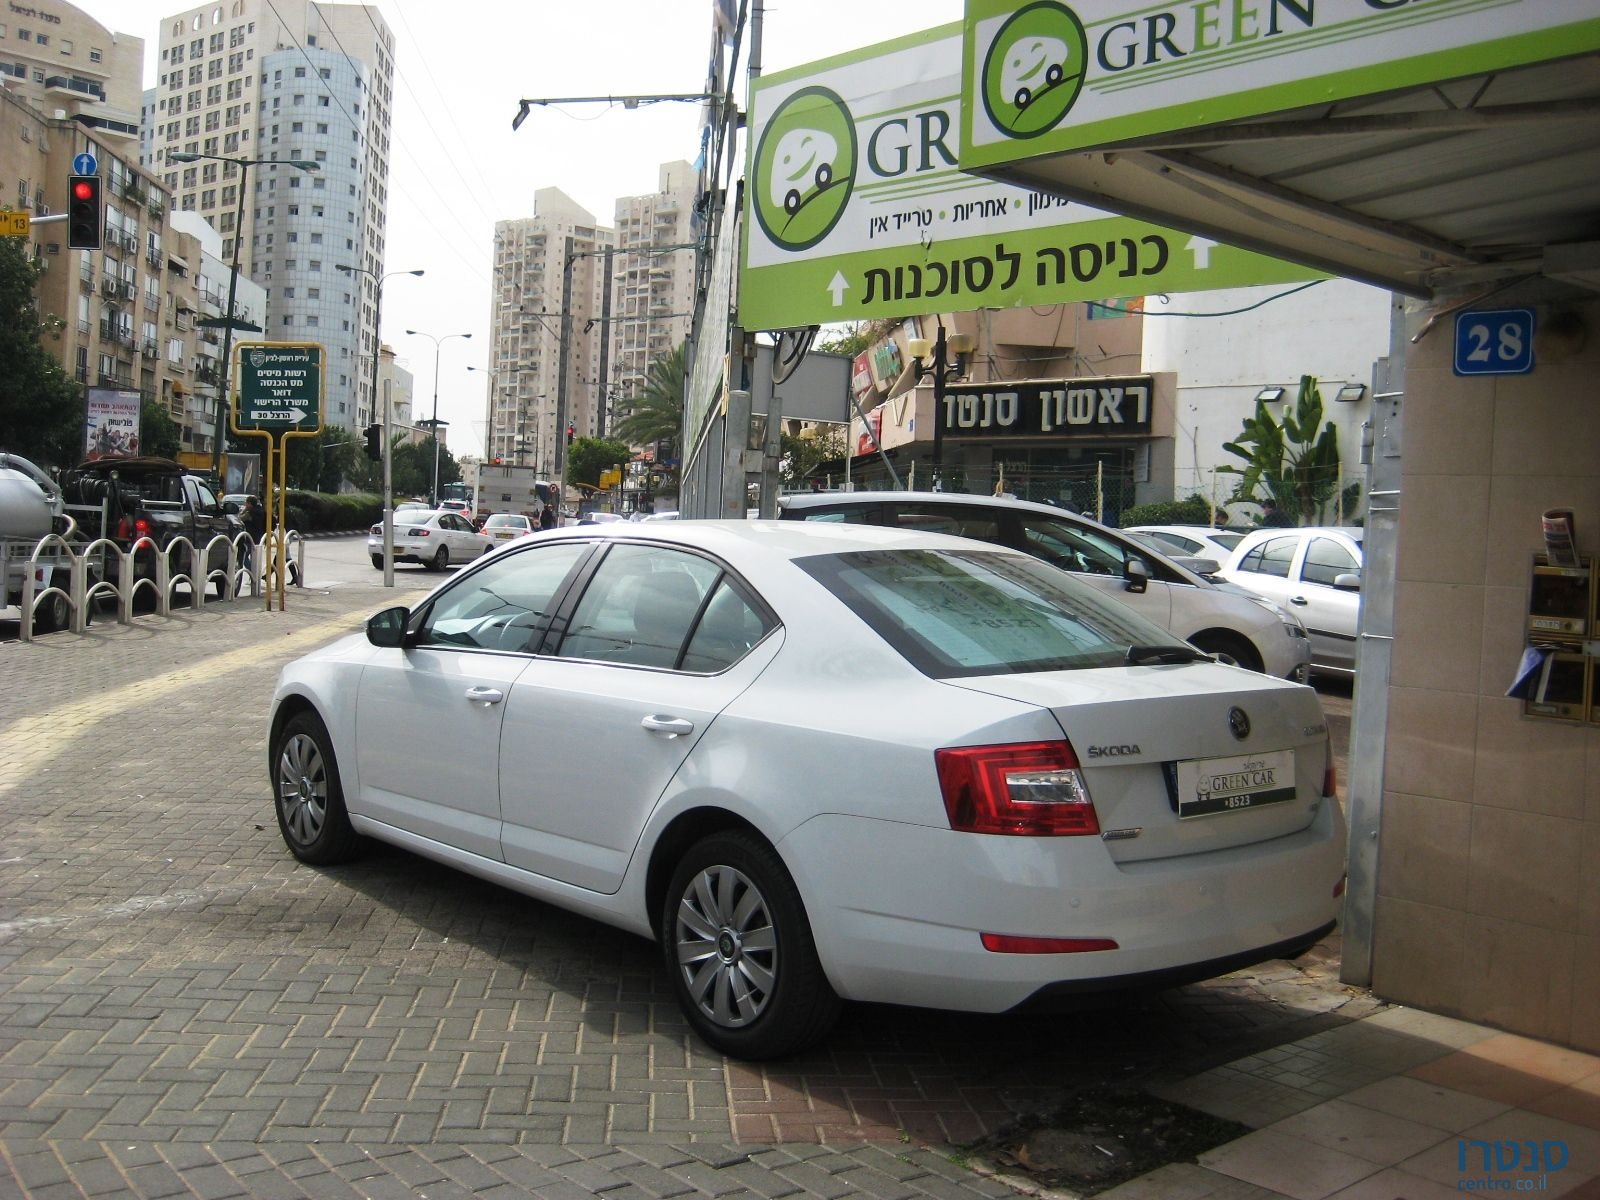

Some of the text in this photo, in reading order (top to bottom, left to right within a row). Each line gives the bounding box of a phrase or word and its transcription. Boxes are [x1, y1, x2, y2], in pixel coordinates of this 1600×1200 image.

[1096, 0, 1314, 72] GREEN
[892, 208, 933, 230] טרייד
[952, 197, 1008, 223] אחריות
[14, 218, 26, 230] 13
[869, 215, 889, 239] אין
[861, 235, 1169, 304] כניסה לסוכנות
[1466, 322, 1523, 362] 28
[257, 369, 307, 377] רשות מיסים
[260, 379, 304, 387] מס הכנסה
[271, 389, 292, 397] דואר
[270, 410, 291, 419] הרצל
[1039, 387, 1149, 432] ראשון
[1088, 744, 1142, 758] ŠKODA
[1212, 770, 1275, 791] GREEN CAR
